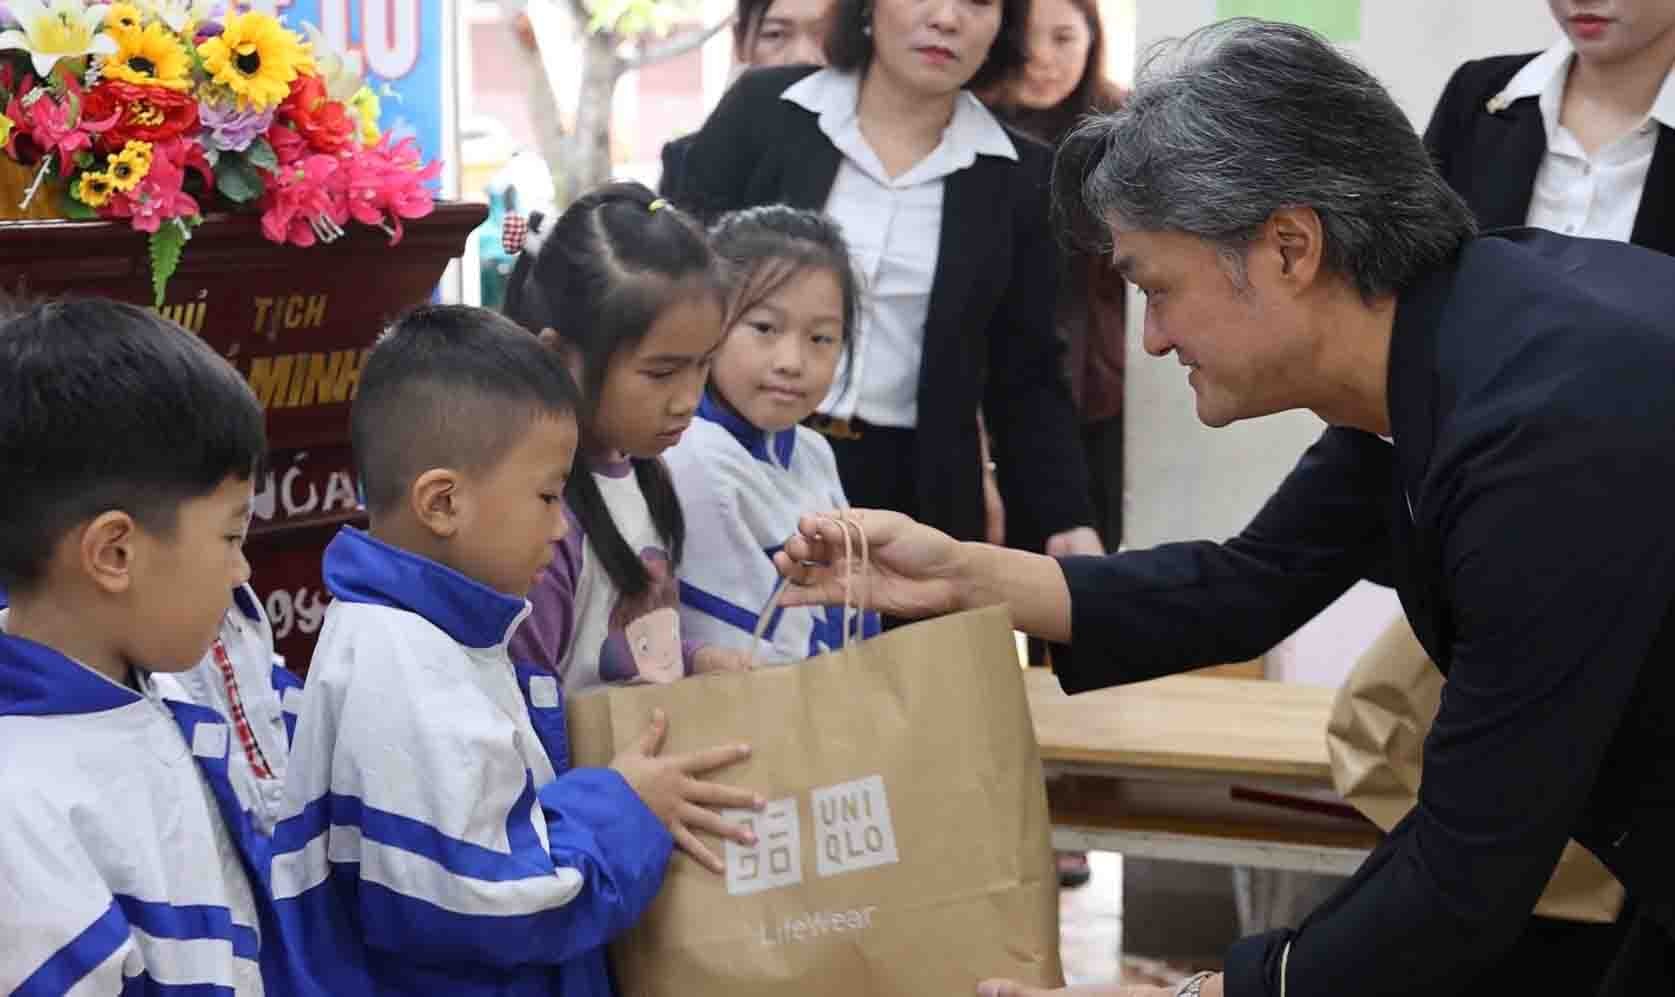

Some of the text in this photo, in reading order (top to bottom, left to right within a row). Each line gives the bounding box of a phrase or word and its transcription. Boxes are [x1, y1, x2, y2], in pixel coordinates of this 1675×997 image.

[248, 348, 369, 409] MINH
[819, 788, 873, 827] UNI
[825, 825, 883, 865] QLO
